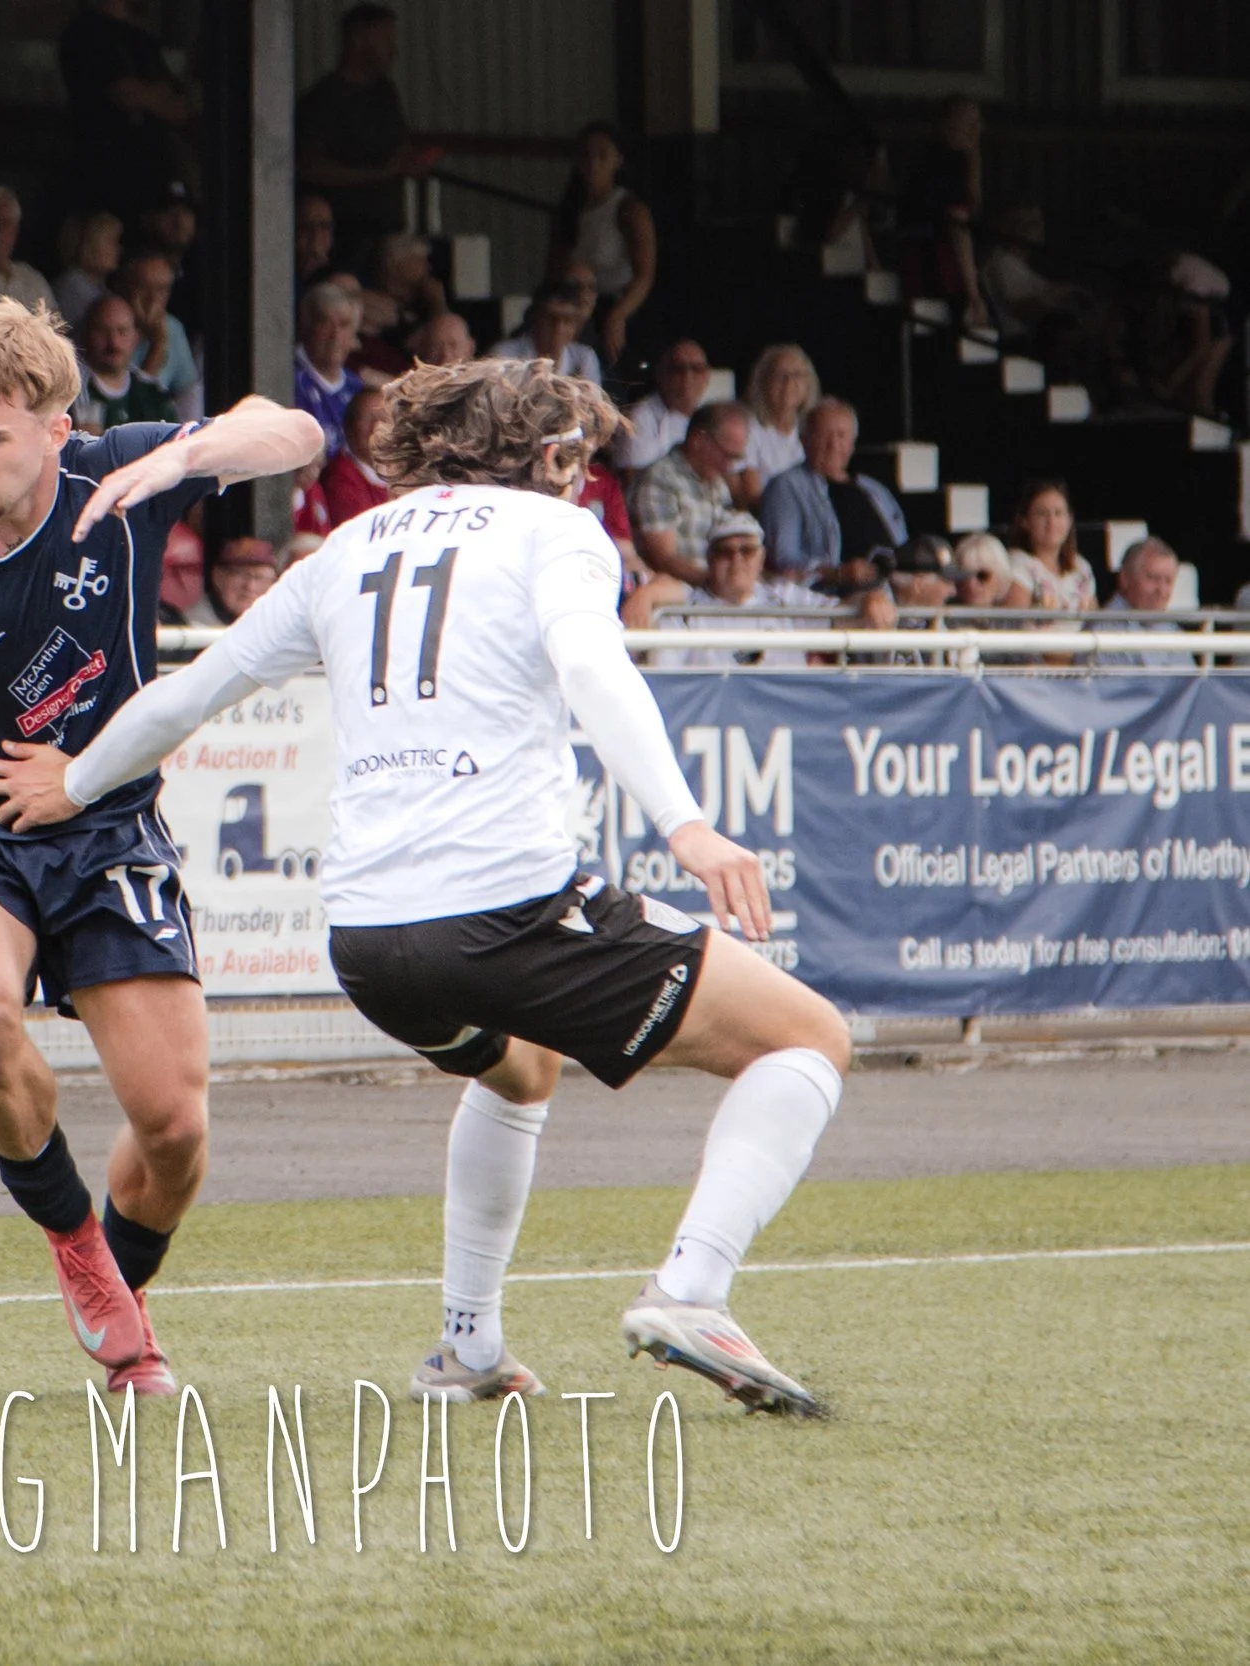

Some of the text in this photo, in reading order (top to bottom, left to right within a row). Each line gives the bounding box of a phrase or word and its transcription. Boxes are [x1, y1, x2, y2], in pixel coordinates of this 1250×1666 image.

[369, 506, 495, 543] WATTS
[359, 546, 459, 708] 11
[14, 632, 66, 697] McArthur
[26, 673, 54, 704] Glen
[253, 699, 305, 725] 4x4's
[194, 744, 277, 770] Auction
[283, 744, 299, 770] It
[843, 725, 959, 797] Your
[969, 727, 1095, 796] Local
[1097, 723, 1218, 810] Legal
[875, 837, 1250, 896] Official Legal Partners of Merthy
[105, 864, 170, 924] 17
[190, 905, 284, 938] Thursday
[292, 906, 312, 931] at
[220, 948, 320, 976] Available
[899, 926, 1250, 976] Call us today for a free consultation: 01
